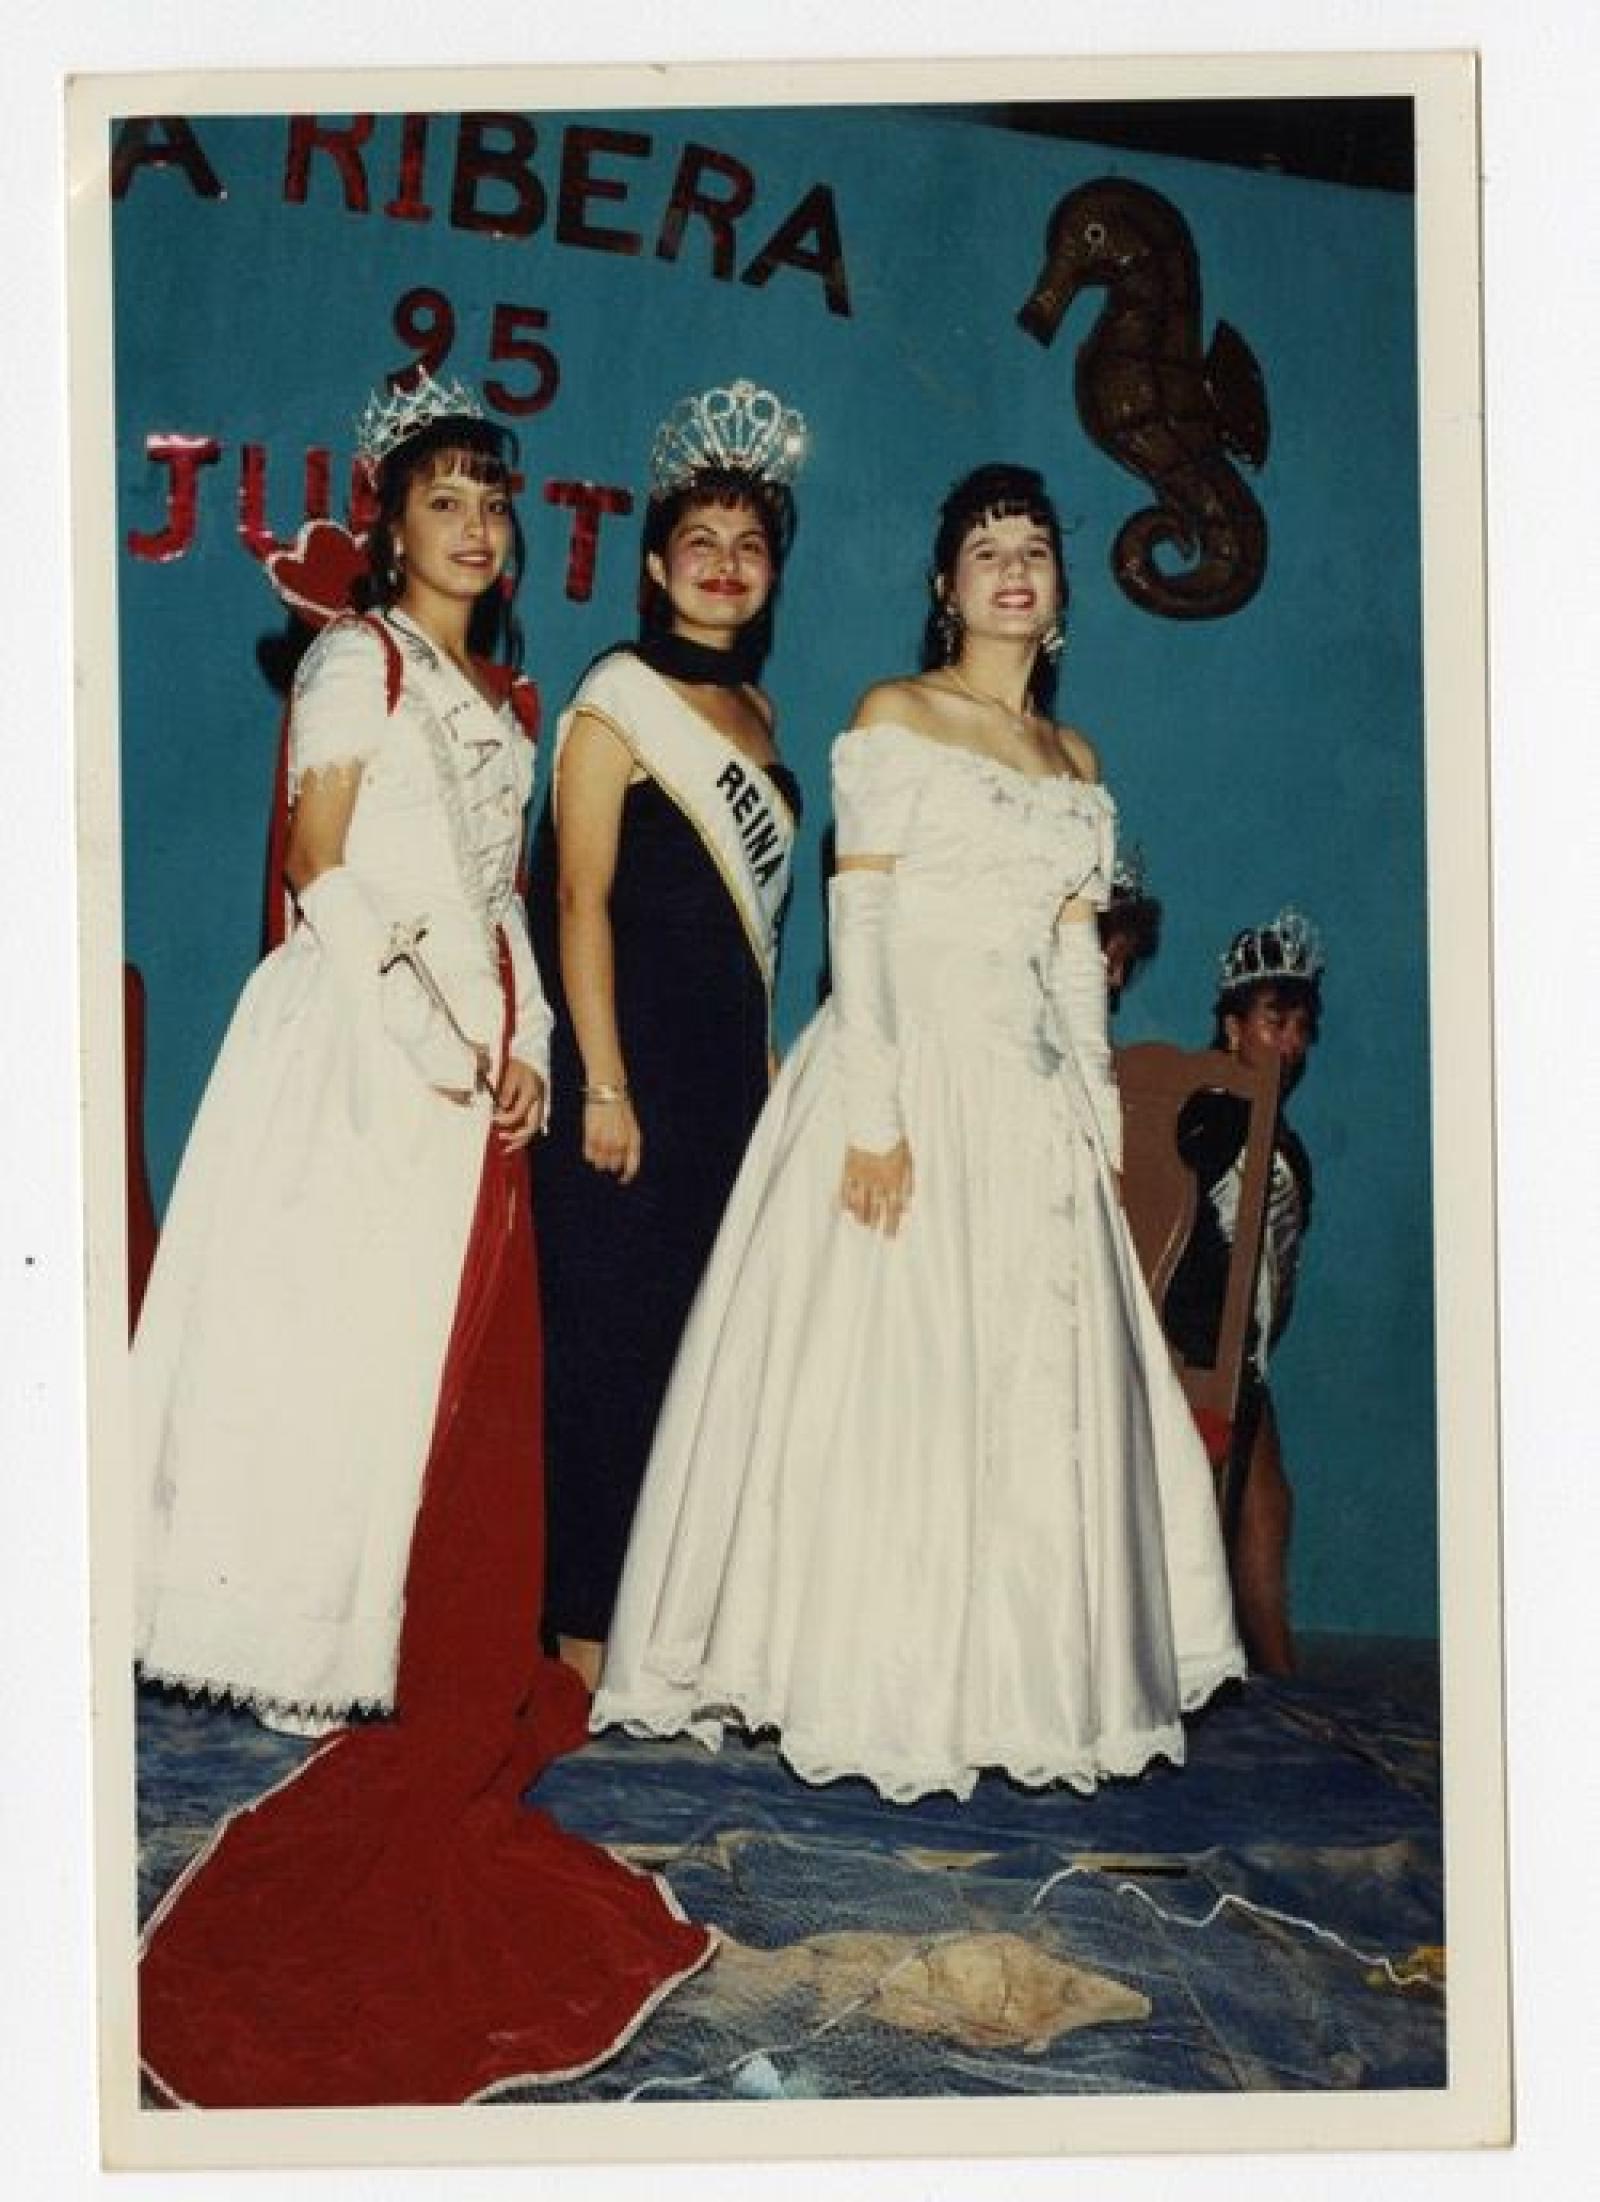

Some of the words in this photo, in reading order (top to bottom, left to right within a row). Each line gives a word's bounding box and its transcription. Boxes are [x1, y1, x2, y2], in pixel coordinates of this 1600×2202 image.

[112, 115, 224, 200] A
[284, 113, 851, 318] RIBERA
[386, 288, 560, 416] 95
[716, 761, 785, 886] REINA
